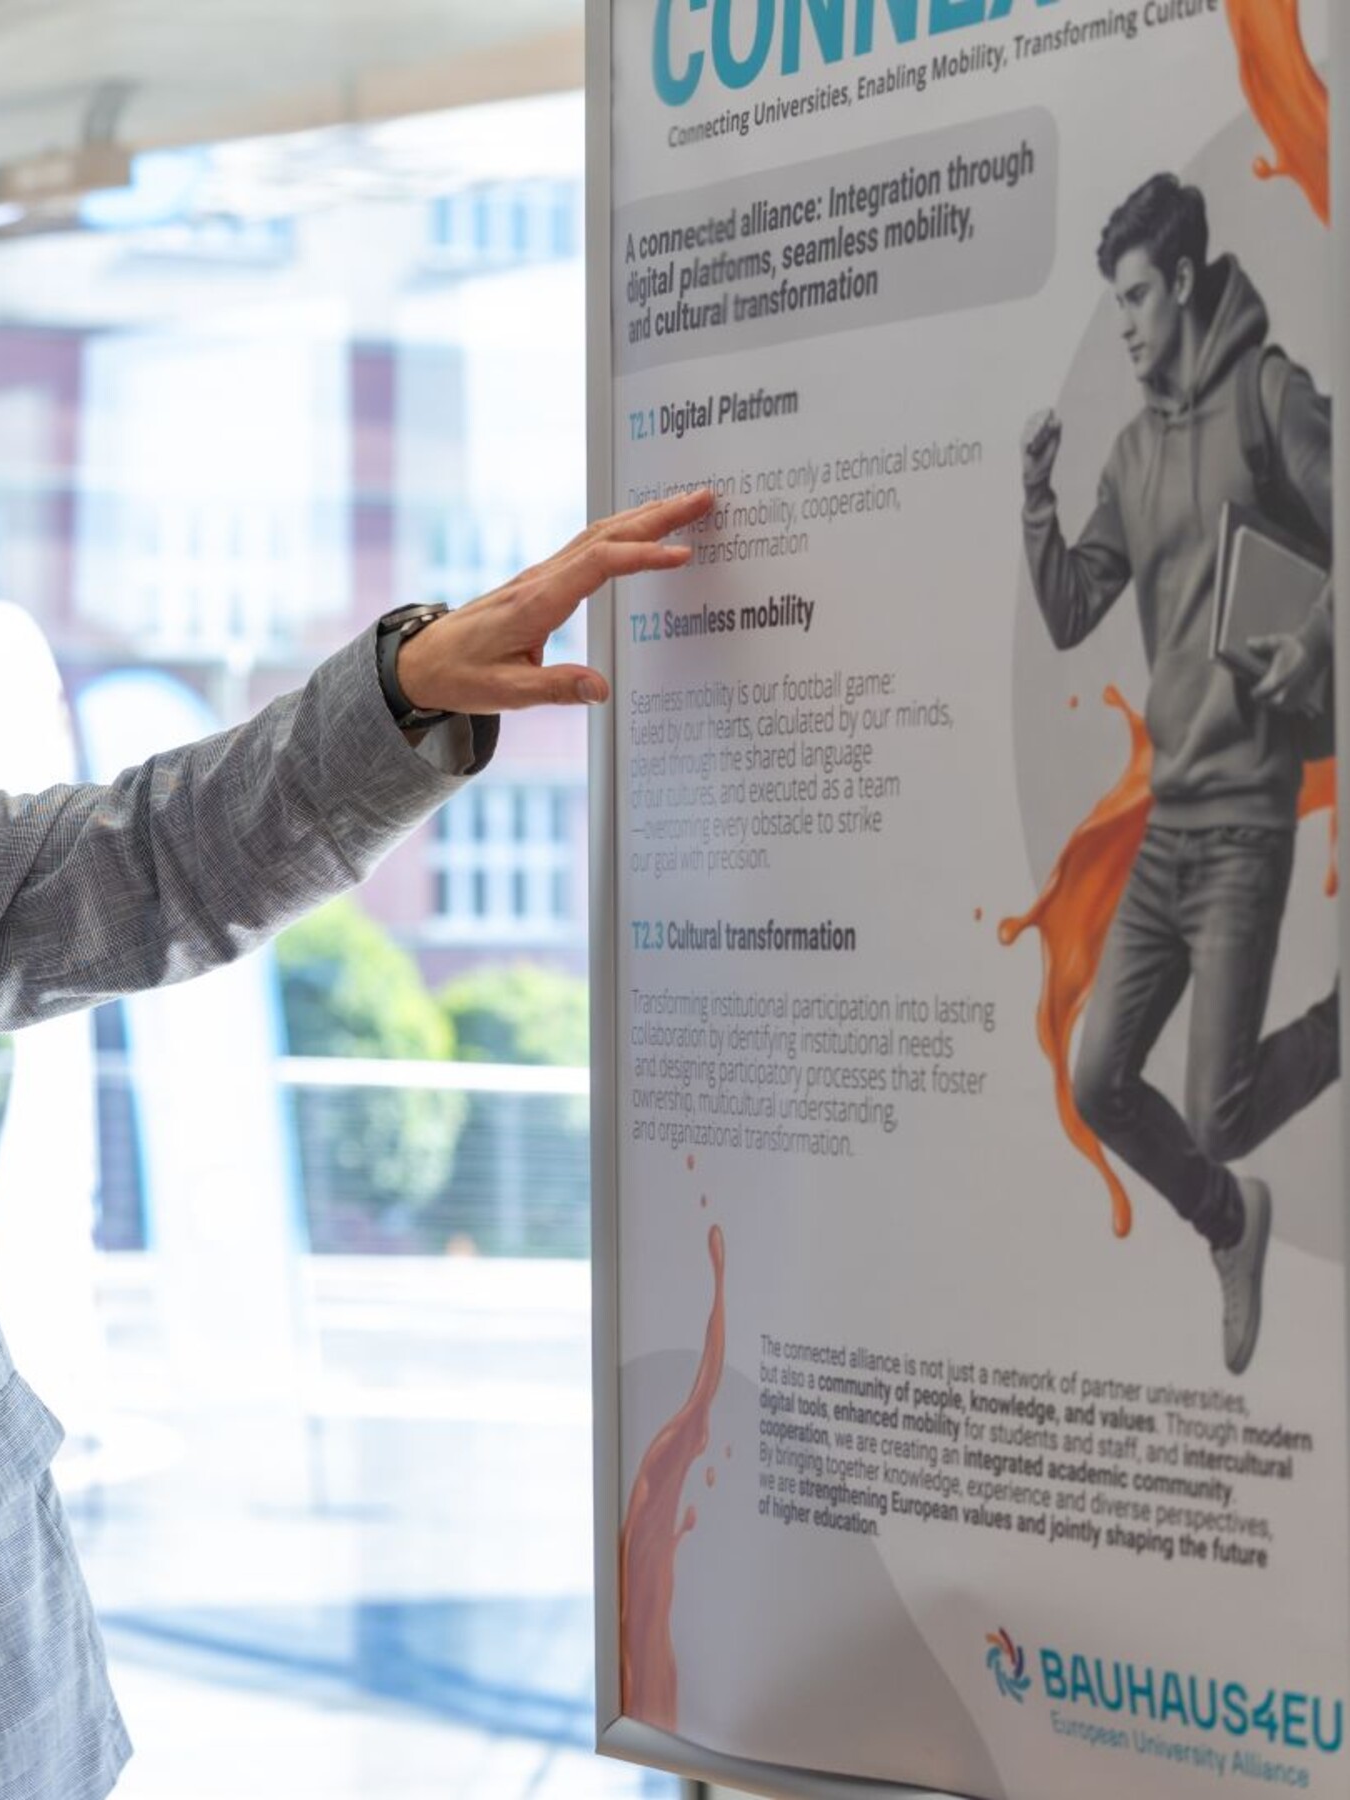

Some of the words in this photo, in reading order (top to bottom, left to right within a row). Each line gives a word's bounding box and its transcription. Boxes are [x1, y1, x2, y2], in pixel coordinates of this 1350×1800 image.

[668, 111, 750, 147] Connecting
[754, 87, 852, 126] Universities,
[856, 67, 926, 100] Enabling
[932, 48, 1008, 81] Mobility,
[1014, 15, 1138, 60] Transforming
[1144, 0, 1218, 27] Culture
[625, 231, 636, 264] A
[639, 208, 736, 261] connected
[740, 197, 822, 238] alliance:
[828, 170, 940, 218] Integration
[947, 142, 1034, 192] through
[626, 263, 674, 309] digital
[680, 252, 776, 300] platforms,
[782, 227, 878, 271] seamless
[884, 205, 974, 248] mobility,
[628, 308, 651, 344] and
[654, 293, 727, 338] cultural
[733, 269, 878, 323] transformation
[630, 407, 656, 440] T2.1
[660, 397, 714, 438] Digital
[718, 390, 798, 425] Platform
[740, 468, 752, 493] is
[756, 465, 782, 490] not
[786, 457, 820, 491] only
[822, 463, 831, 482] a
[834, 444, 908, 480] technical
[912, 439, 982, 469] solution
[714, 504, 730, 530] of
[732, 498, 798, 529] mobility,
[802, 488, 901, 523] cooperation,
[698, 529, 808, 566] transformation
[630, 610, 660, 643] T2.2
[664, 605, 735, 639] Seamless
[740, 595, 814, 632] mobility
[630, 685, 683, 714] Seamless
[686, 680, 734, 714] mobility
[738, 680, 748, 706] is
[753, 684, 780, 704] our
[782, 670, 842, 702] football
[845, 674, 896, 704] game:
[708, 713, 754, 743] hearts,
[757, 705, 834, 738] calculated
[838, 704, 859, 739] by
[862, 709, 891, 731] our
[896, 698, 954, 730] minds,
[746, 742, 796, 771] shared
[801, 741, 873, 773] language
[720, 777, 745, 805] and
[749, 774, 817, 803] executed
[821, 779, 840, 800] as
[843, 779, 854, 799] a
[858, 776, 900, 798] team
[750, 807, 813, 836] obstacle
[817, 811, 834, 834] to
[838, 805, 882, 833] strike
[632, 920, 664, 950] T2.3
[667, 920, 722, 950] Cultural
[724, 920, 856, 951] transformation
[792, 994, 890, 1027] participation
[894, 996, 930, 1023] into
[934, 996, 996, 1032] lasting
[802, 1028, 894, 1056] institutional
[898, 1031, 954, 1058] needs
[718, 1059, 802, 1093] participatory
[806, 1066, 886, 1094] processes
[891, 1065, 926, 1091] that
[932, 1066, 988, 1094] foster
[760, 1334, 780, 1357] The
[784, 1342, 846, 1366] connected
[849, 1347, 900, 1373] alliance
[904, 1355, 916, 1375] is
[919, 1360, 944, 1379] not
[947, 1361, 974, 1385] just
[978, 1368, 988, 1384] a
[992, 1370, 1056, 1393] network
[1060, 1374, 1077, 1395] of
[1081, 1380, 1142, 1402] partner
[760, 1361, 778, 1384] but
[780, 1364, 804, 1387] also
[808, 1372, 814, 1388] a
[818, 1373, 890, 1403] community
[894, 1379, 910, 1400] of
[913, 1385, 966, 1411] people,
[970, 1388, 1060, 1423] knowledge,
[1064, 1402, 1094, 1423] and
[1165, 1412, 1236, 1445] Through
[1242, 1426, 1313, 1451] modern
[760, 1386, 794, 1414] digital
[834, 1399, 898, 1425] enhanced
[902, 1409, 960, 1439] mobility
[965, 1414, 986, 1437] for
[989, 1421, 1058, 1447] students
[1062, 1431, 1094, 1452] and
[1146, 1442, 1178, 1463] and
[1183, 1446, 1293, 1480] intercultural
[760, 1419, 831, 1449] cooperation,
[834, 1430, 853, 1448] we
[856, 1433, 878, 1452] are
[881, 1437, 938, 1466] creating
[942, 1446, 959, 1464] an
[964, 1446, 1043, 1476] integrated
[1048, 1461, 1128, 1488] academic
[758, 1497, 770, 1516] of
[773, 1498, 810, 1525] higher
[760, 1443, 774, 1469] By
[776, 1445, 823, 1476] bringing
[826, 1455, 880, 1480] together
[883, 1461, 963, 1496] knowledge,
[967, 1478, 1050, 1505] experience
[1056, 1490, 1085, 1510] and
[1090, 1493, 1150, 1520] diverse
[1155, 1506, 1273, 1543] perspectives,
[758, 1472, 774, 1490] we
[778, 1475, 796, 1493] are
[799, 1478, 888, 1515] strengthening
[890, 1489, 959, 1522] European
[962, 1503, 1012, 1527] values
[1016, 1512, 1046, 1532] and
[1049, 1515, 1102, 1548] jointly
[1105, 1525, 1174, 1560] shaping
[1178, 1536, 1207, 1558] the
[1212, 1540, 1268, 1567] future
[1039, 1648, 1343, 1754] BAUHAUS4EU
[1051, 1709, 1130, 1749] European
[1133, 1729, 1226, 1776] University
[1232, 1750, 1310, 1789] Alliance
